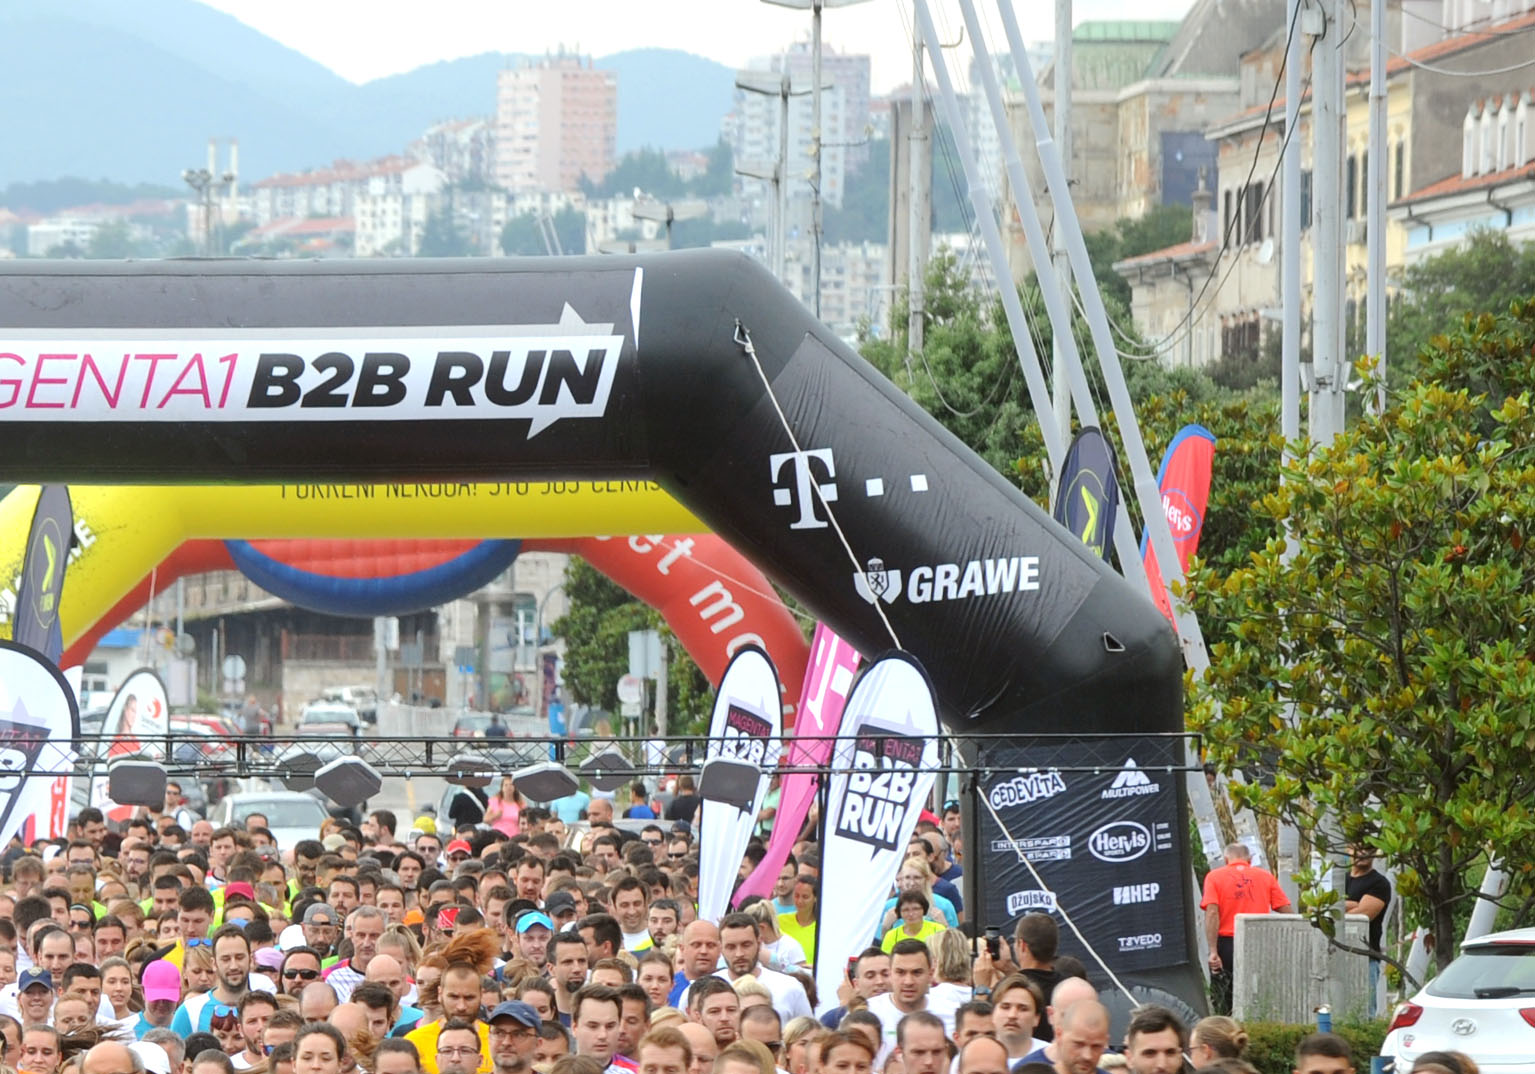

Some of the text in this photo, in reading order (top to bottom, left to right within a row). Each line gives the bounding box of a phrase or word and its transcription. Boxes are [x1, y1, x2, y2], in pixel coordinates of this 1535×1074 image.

[245, 351, 412, 409] B2B
[423, 348, 610, 408] RUN
[907, 556, 1040, 604] GRAWE
[848, 750, 916, 804] B2B
[990, 773, 1066, 810] CEDEVITA
[1101, 783, 1160, 800] MULTIPOWER
[839, 791, 905, 844] RUN
[1096, 831, 1146, 852] Hervis
[1130, 883, 1160, 903] HEP
